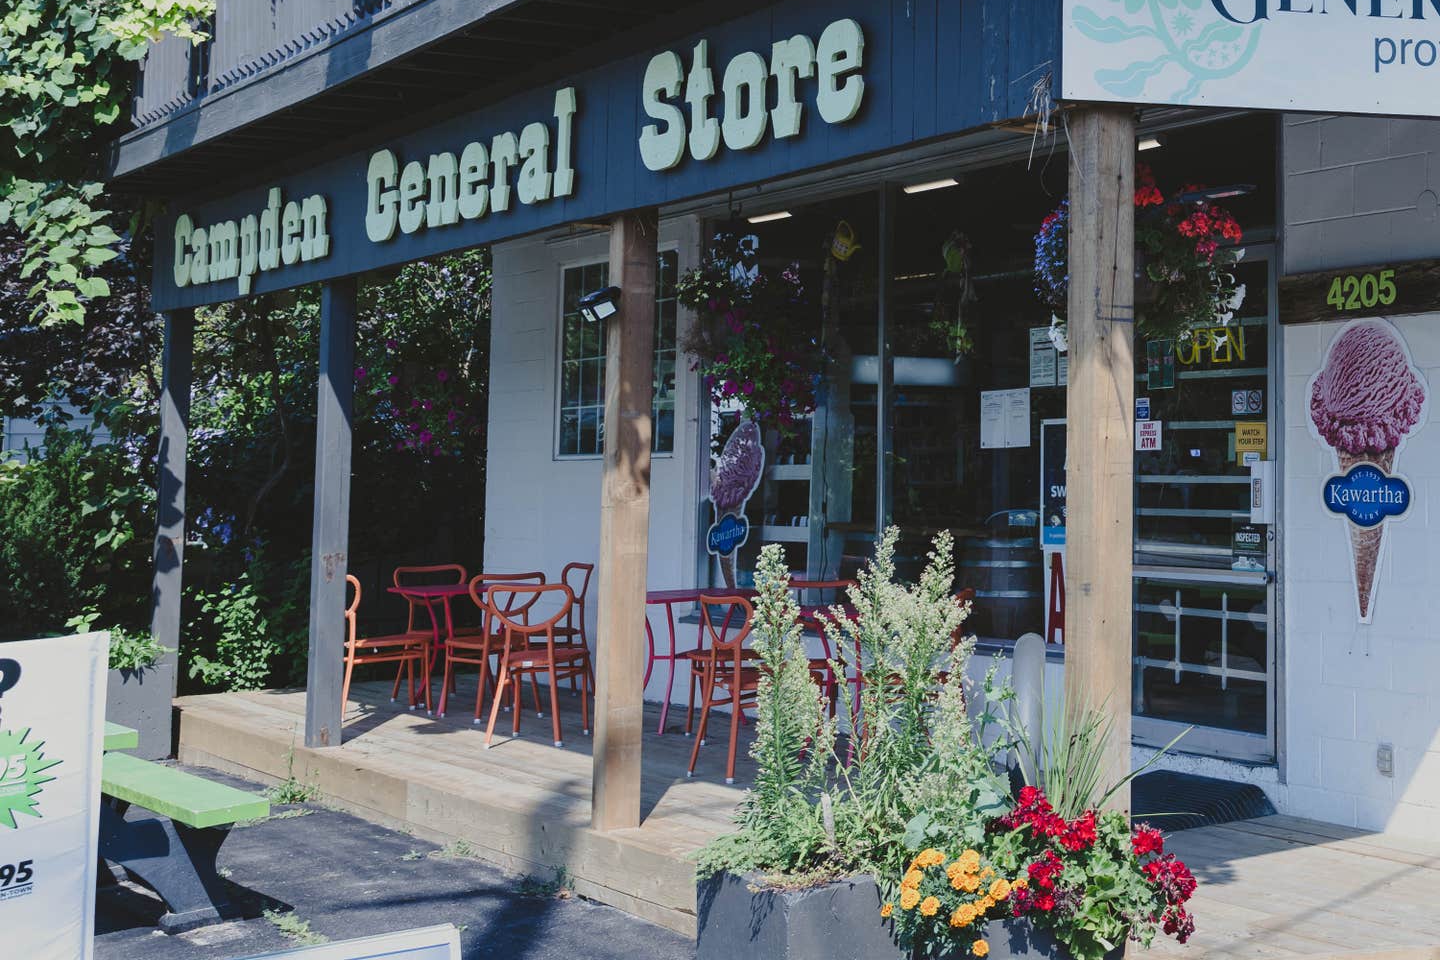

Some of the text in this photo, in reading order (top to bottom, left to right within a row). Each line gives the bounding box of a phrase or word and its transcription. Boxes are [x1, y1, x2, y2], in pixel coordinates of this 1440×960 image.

[172, 17, 867, 296] Campden General Store
[1327, 269, 1397, 310] 4205
[1176, 326, 1245, 364] OPEN
[1141, 438, 1157, 448] ATM
[1238, 437, 1264, 446] YOUR STEP
[1241, 428, 1260, 436] WATCH
[1329, 484, 1403, 506] Kawartha
[1351, 508, 1380, 521] DAIRY
[710, 524, 745, 546] Kawartha
